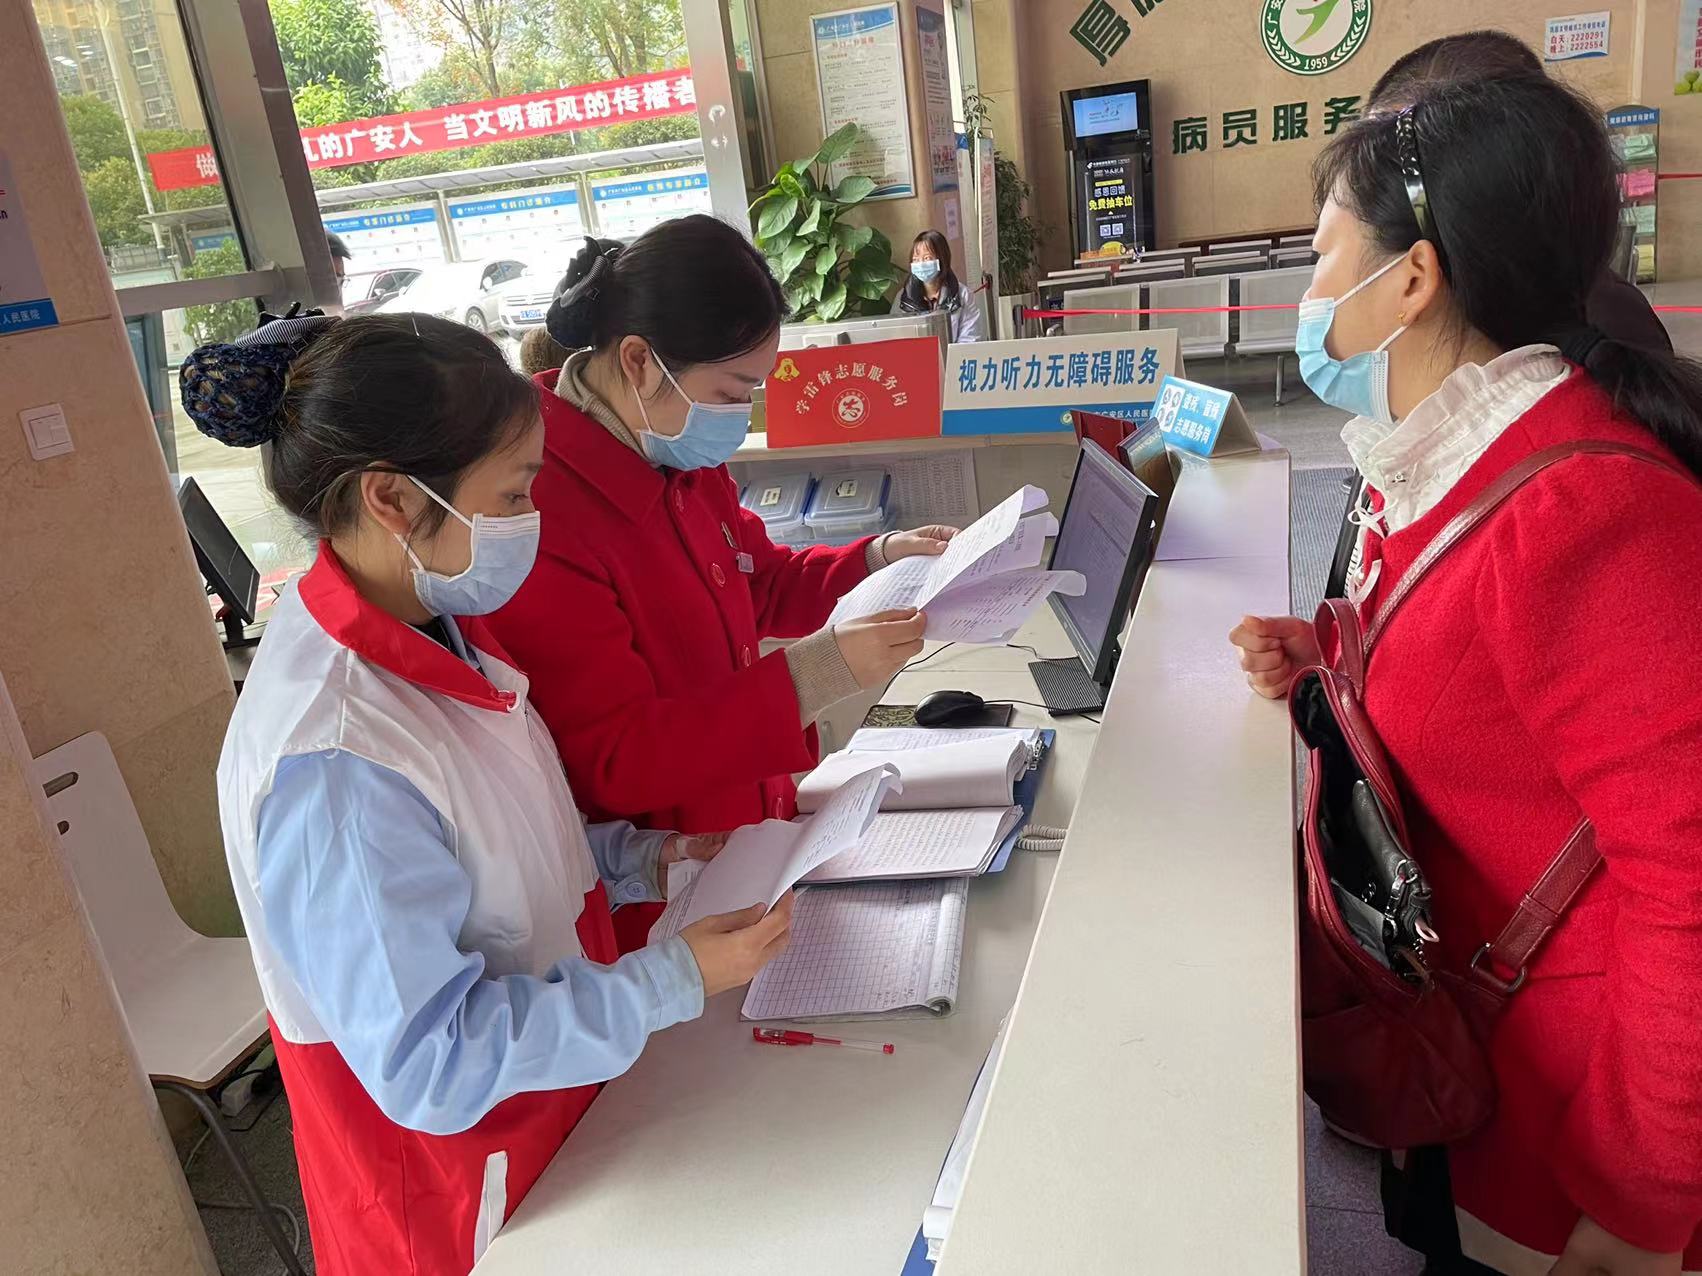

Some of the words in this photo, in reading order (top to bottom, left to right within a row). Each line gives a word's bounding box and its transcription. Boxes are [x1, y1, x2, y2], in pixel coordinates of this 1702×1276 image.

[1304, 57, 1328, 70] 1959
[443, 76, 697, 141] 当文明新风的传播者
[1172, 95, 1361, 155] 病员服务
[1088, 195, 1133, 211] 免费抽车位
[0, 309, 41, 325] 人民医院
[958, 347, 1161, 393] 视力听力无障碍服务
[795, 362, 908, 415] 学雷锋志愿服务岗
[1095, 409, 1153, 419] 广安区人民医
[1174, 417, 1212, 444] 志愿服务岗
